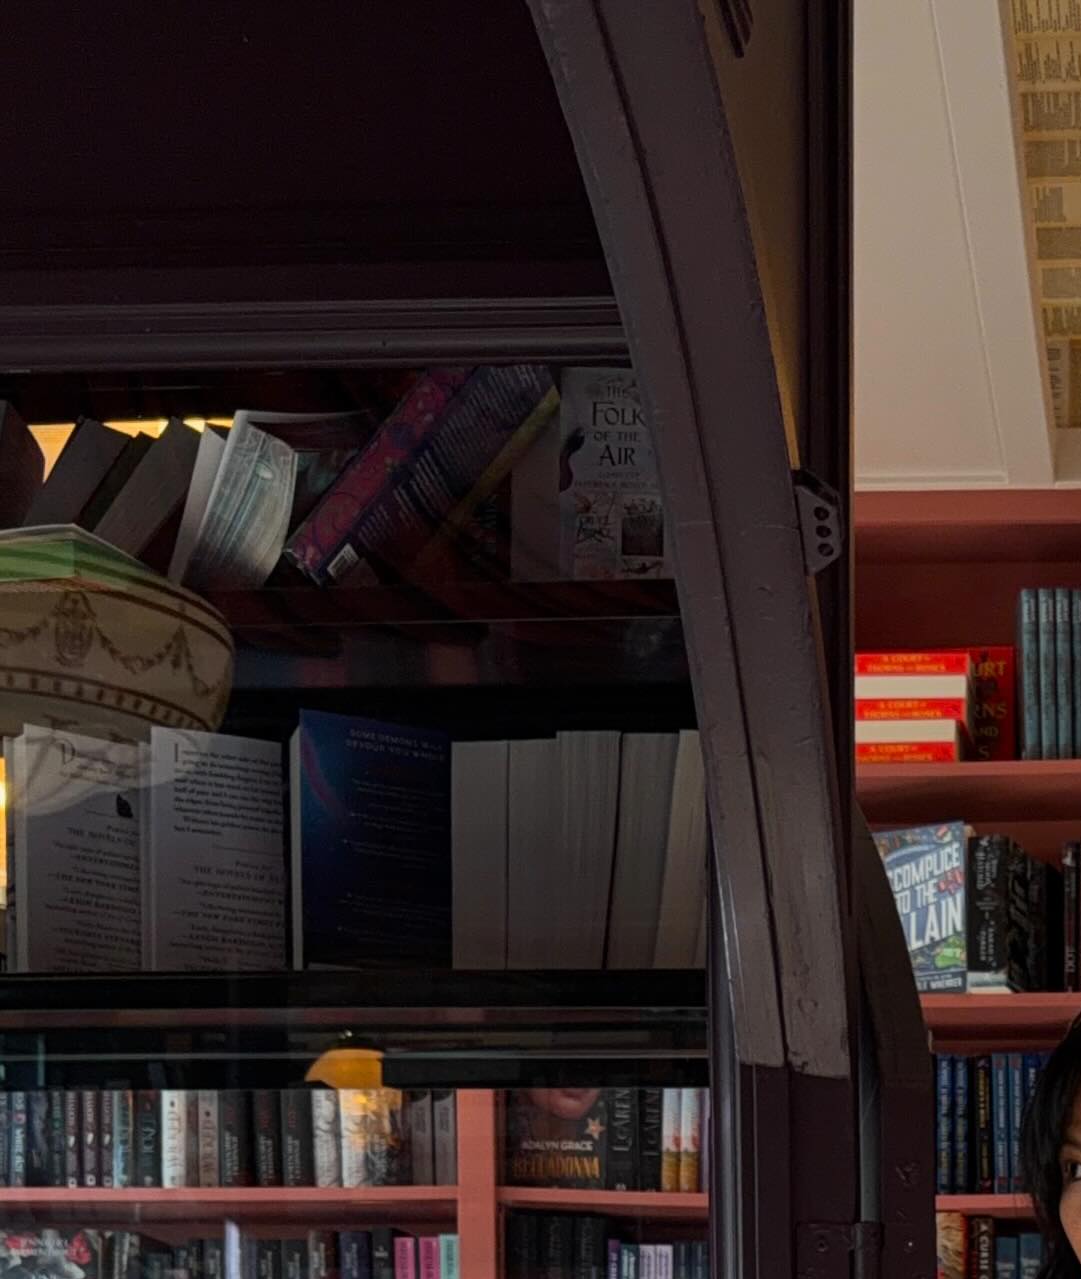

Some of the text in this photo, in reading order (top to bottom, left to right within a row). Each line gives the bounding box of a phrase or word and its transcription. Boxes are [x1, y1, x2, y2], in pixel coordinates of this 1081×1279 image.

[591, 402, 646, 427] FOLK
[599, 445, 637, 467] AIR
[887, 842, 961, 892] COMPLICE
[916, 878, 939, 909] THE
[909, 893, 963, 951] LAIN
[980, 1235, 990, 1271] CURSE
